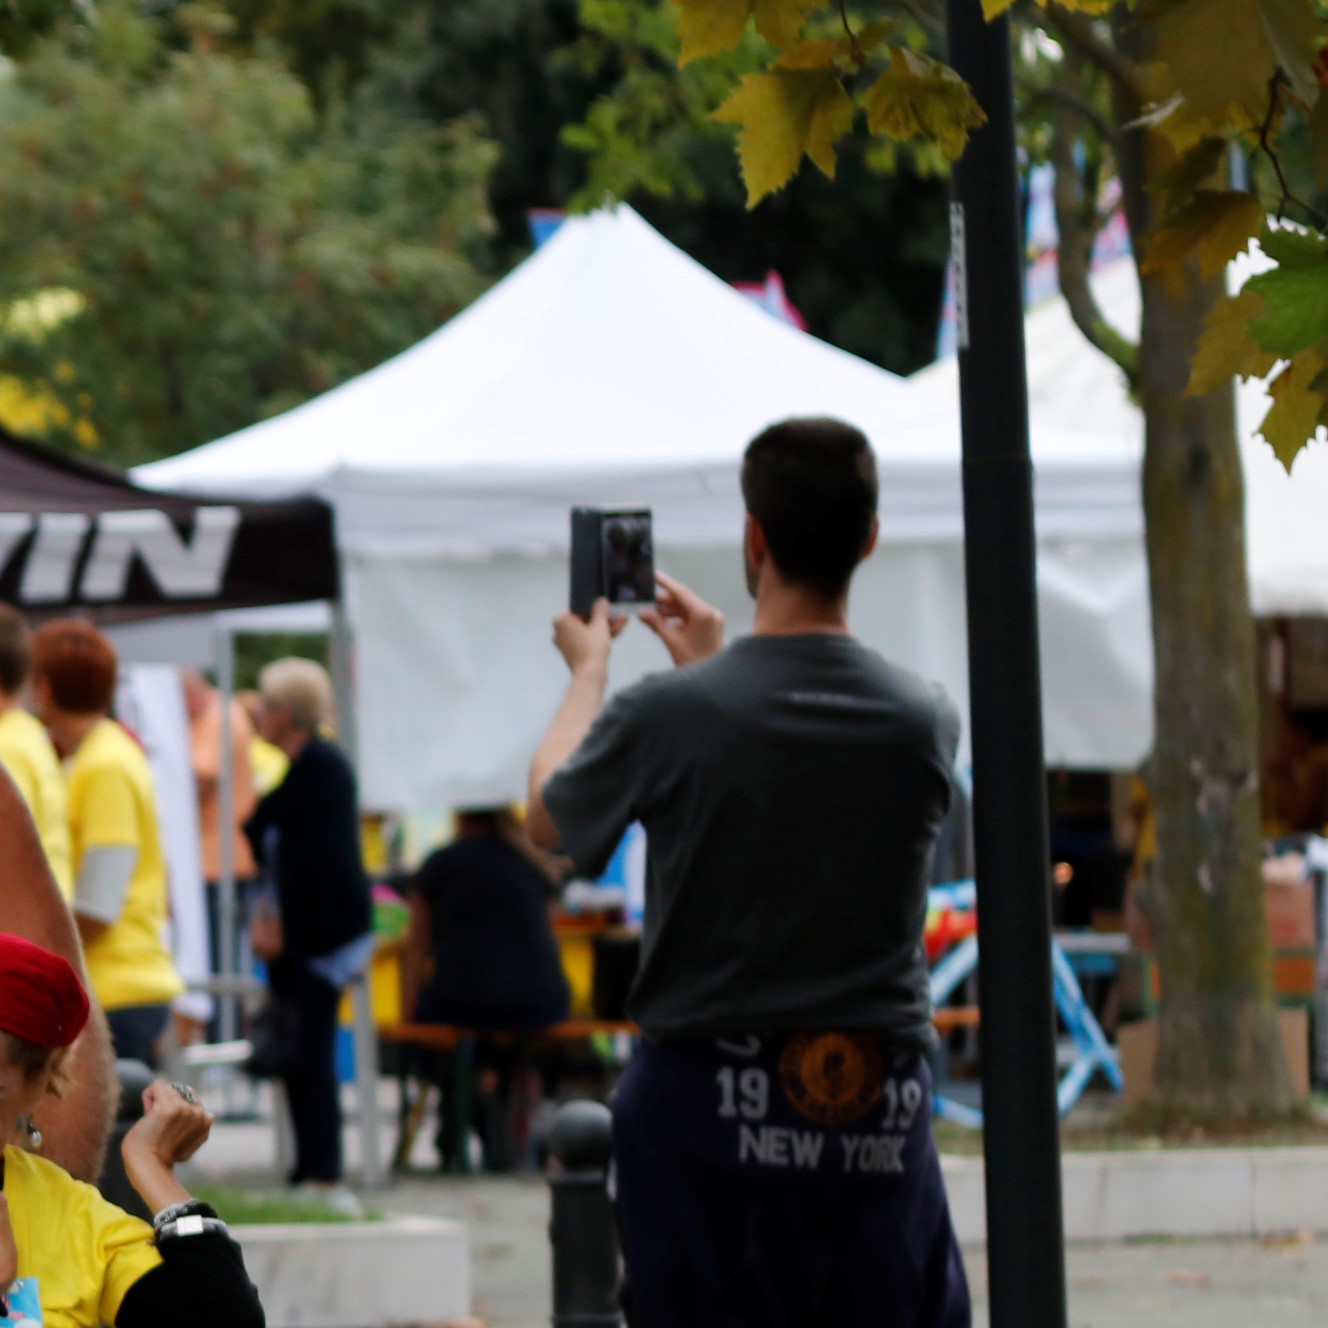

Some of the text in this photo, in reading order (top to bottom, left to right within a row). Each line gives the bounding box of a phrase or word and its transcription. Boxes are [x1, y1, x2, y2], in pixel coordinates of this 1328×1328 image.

[715, 1065, 769, 1120] 19
[882, 1078, 922, 1131] 19
[739, 1124, 906, 1174] NEW YORK
